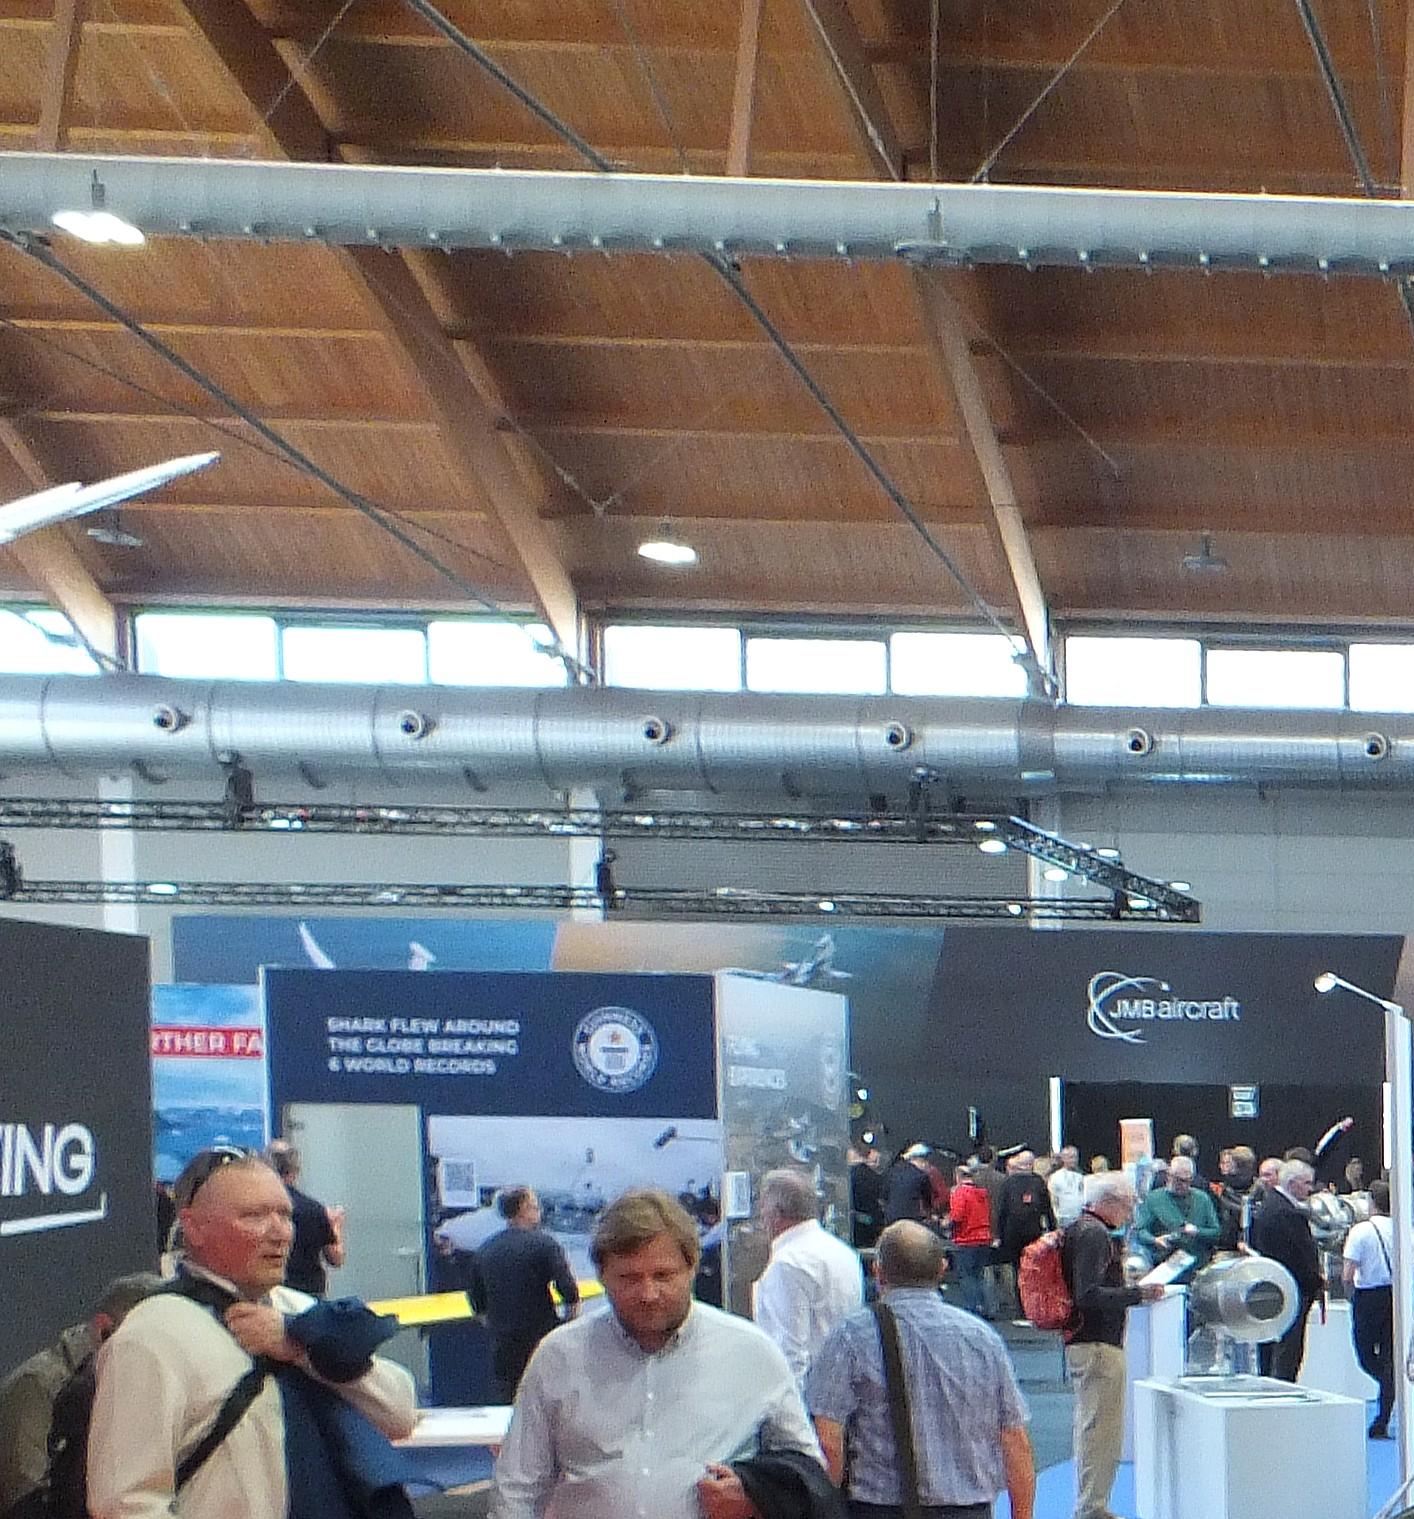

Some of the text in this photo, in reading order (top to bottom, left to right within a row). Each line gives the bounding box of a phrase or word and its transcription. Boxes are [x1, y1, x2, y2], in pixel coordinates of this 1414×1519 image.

[327, 1017, 520, 1036] SHARK FLEW AROUND
[328, 1036, 520, 1056] THE GLOBE BREAKING
[343, 1057, 412, 1074] WORLD
[413, 1058, 497, 1076] RECORDS
[0, 1123, 94, 1196] ING
